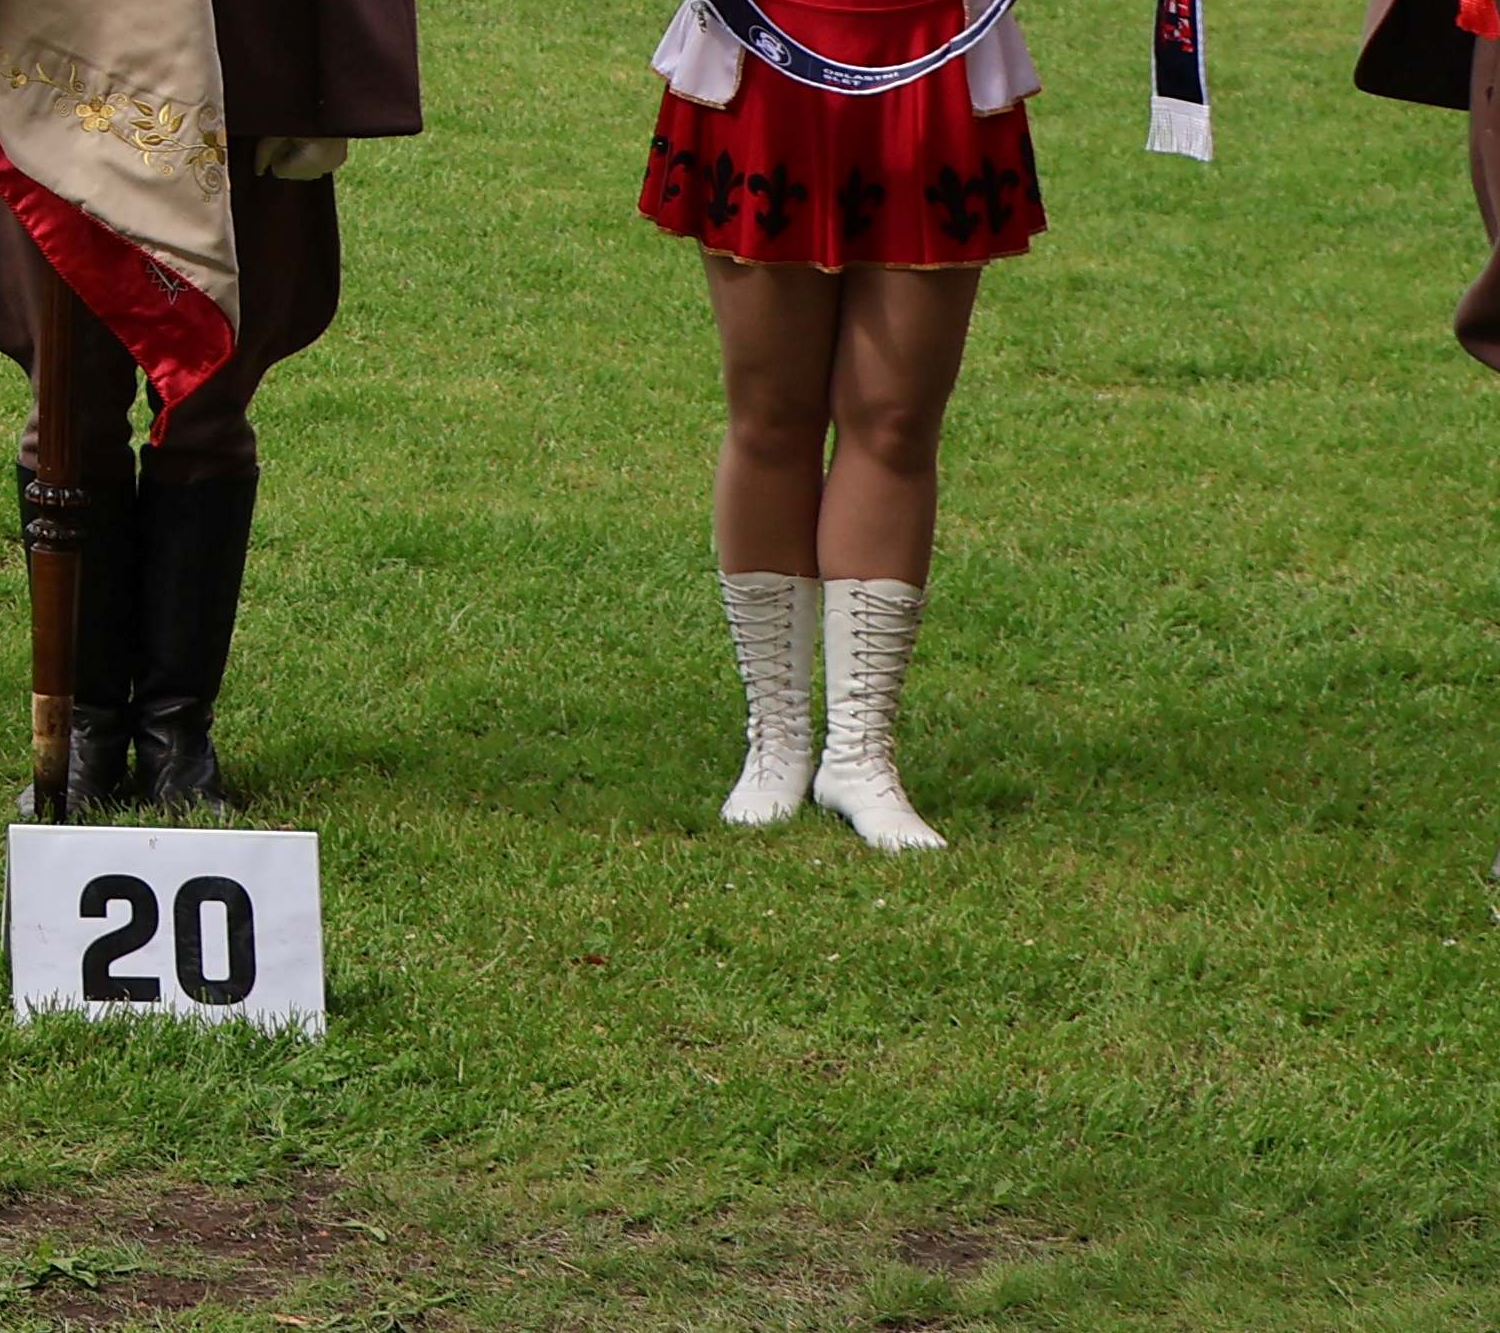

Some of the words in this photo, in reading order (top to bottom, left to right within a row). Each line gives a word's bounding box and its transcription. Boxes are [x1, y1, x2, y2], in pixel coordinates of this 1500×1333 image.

[823, 67, 900, 82] OBLASTNÍ
[823, 74, 861, 86] SLET
[80, 874, 257, 1006] 20
